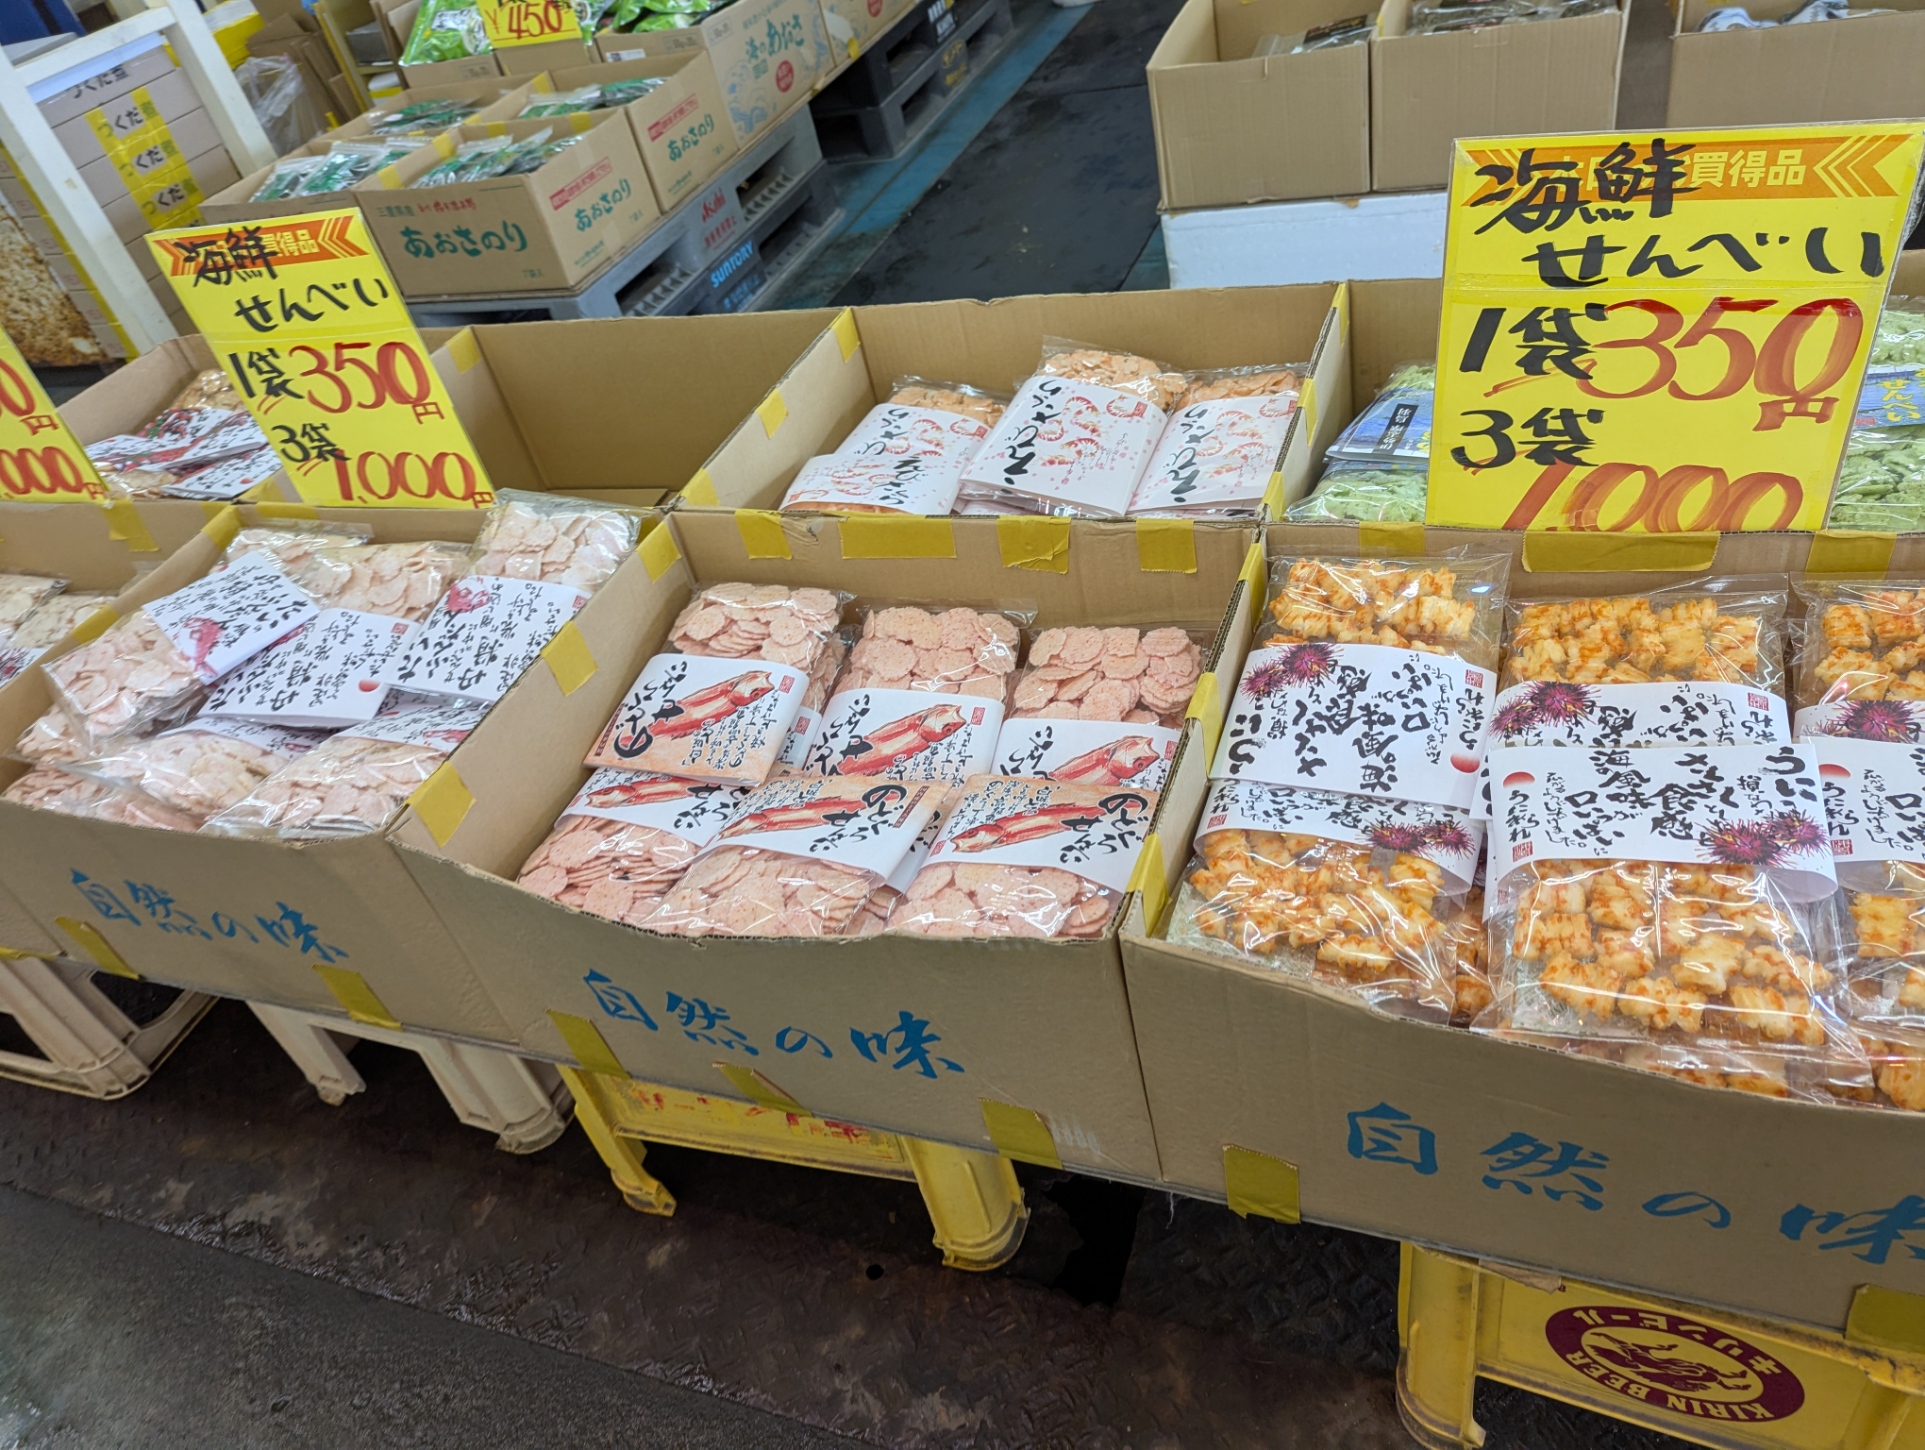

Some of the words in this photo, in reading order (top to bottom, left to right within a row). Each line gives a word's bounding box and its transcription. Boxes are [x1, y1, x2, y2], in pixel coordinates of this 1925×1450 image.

[574, 177, 633, 232] あおさのり
[1470, 138, 1702, 235] 海鮮
[173, 226, 279, 288] 海鮮
[400, 220, 528, 260] あおさのり
[710, 240, 754, 289] SUNTORY
[1522, 227, 1884, 290] せんべい
[234, 277, 390, 333] せんべい
[1876, 378, 1921, 423] せんべい
[1002, 379, 1062, 486] えびさくら
[1162, 404, 1215, 504] えびさくら
[613, 678, 658, 759] のどぐろ
[651, 660, 688, 725] せんべい
[839, 694, 875, 759] せんべい
[808, 809, 863, 853] せんべい
[848, 783, 909, 845] のどぐろ
[1059, 815, 1104, 864] せんべい
[1505, 789, 1541, 843] うにあられ
[70, 868, 350, 965] 自然の味
[583, 968, 966, 1080] 自然の味
[1345, 1102, 1925, 1266] 自然の味
[1572, 1308, 1783, 1376] キリンビール
[1563, 1349, 1651, 1400] BEER
[1666, 1393, 1775, 1419] KIRIN
